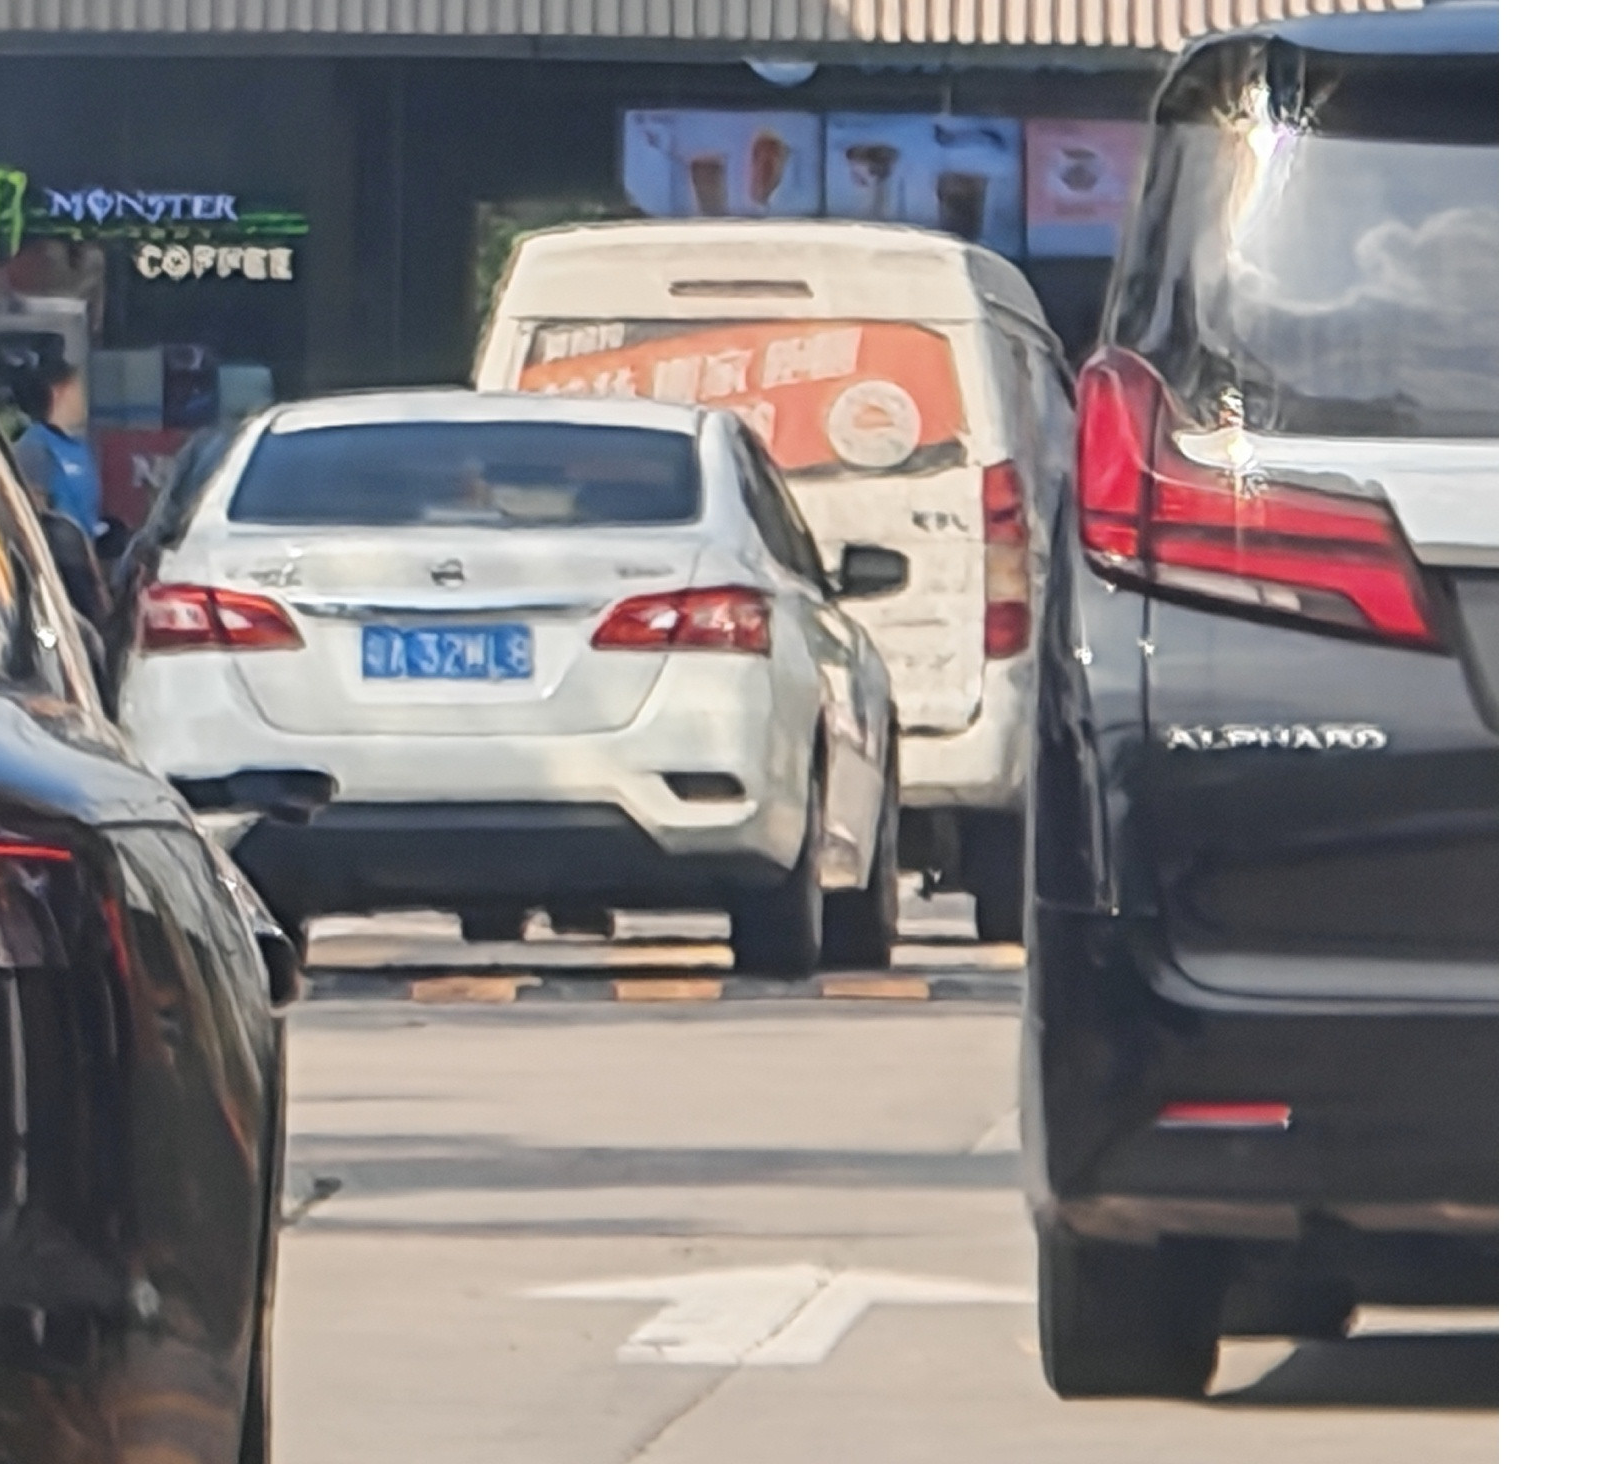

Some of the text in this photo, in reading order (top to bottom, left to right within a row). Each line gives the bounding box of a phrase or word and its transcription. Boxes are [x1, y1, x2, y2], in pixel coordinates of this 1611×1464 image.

[44, 187, 239, 224] MONSTER
[133, 243, 295, 282] COFFEE
[1164, 722, 1389, 751] ALPHARD
